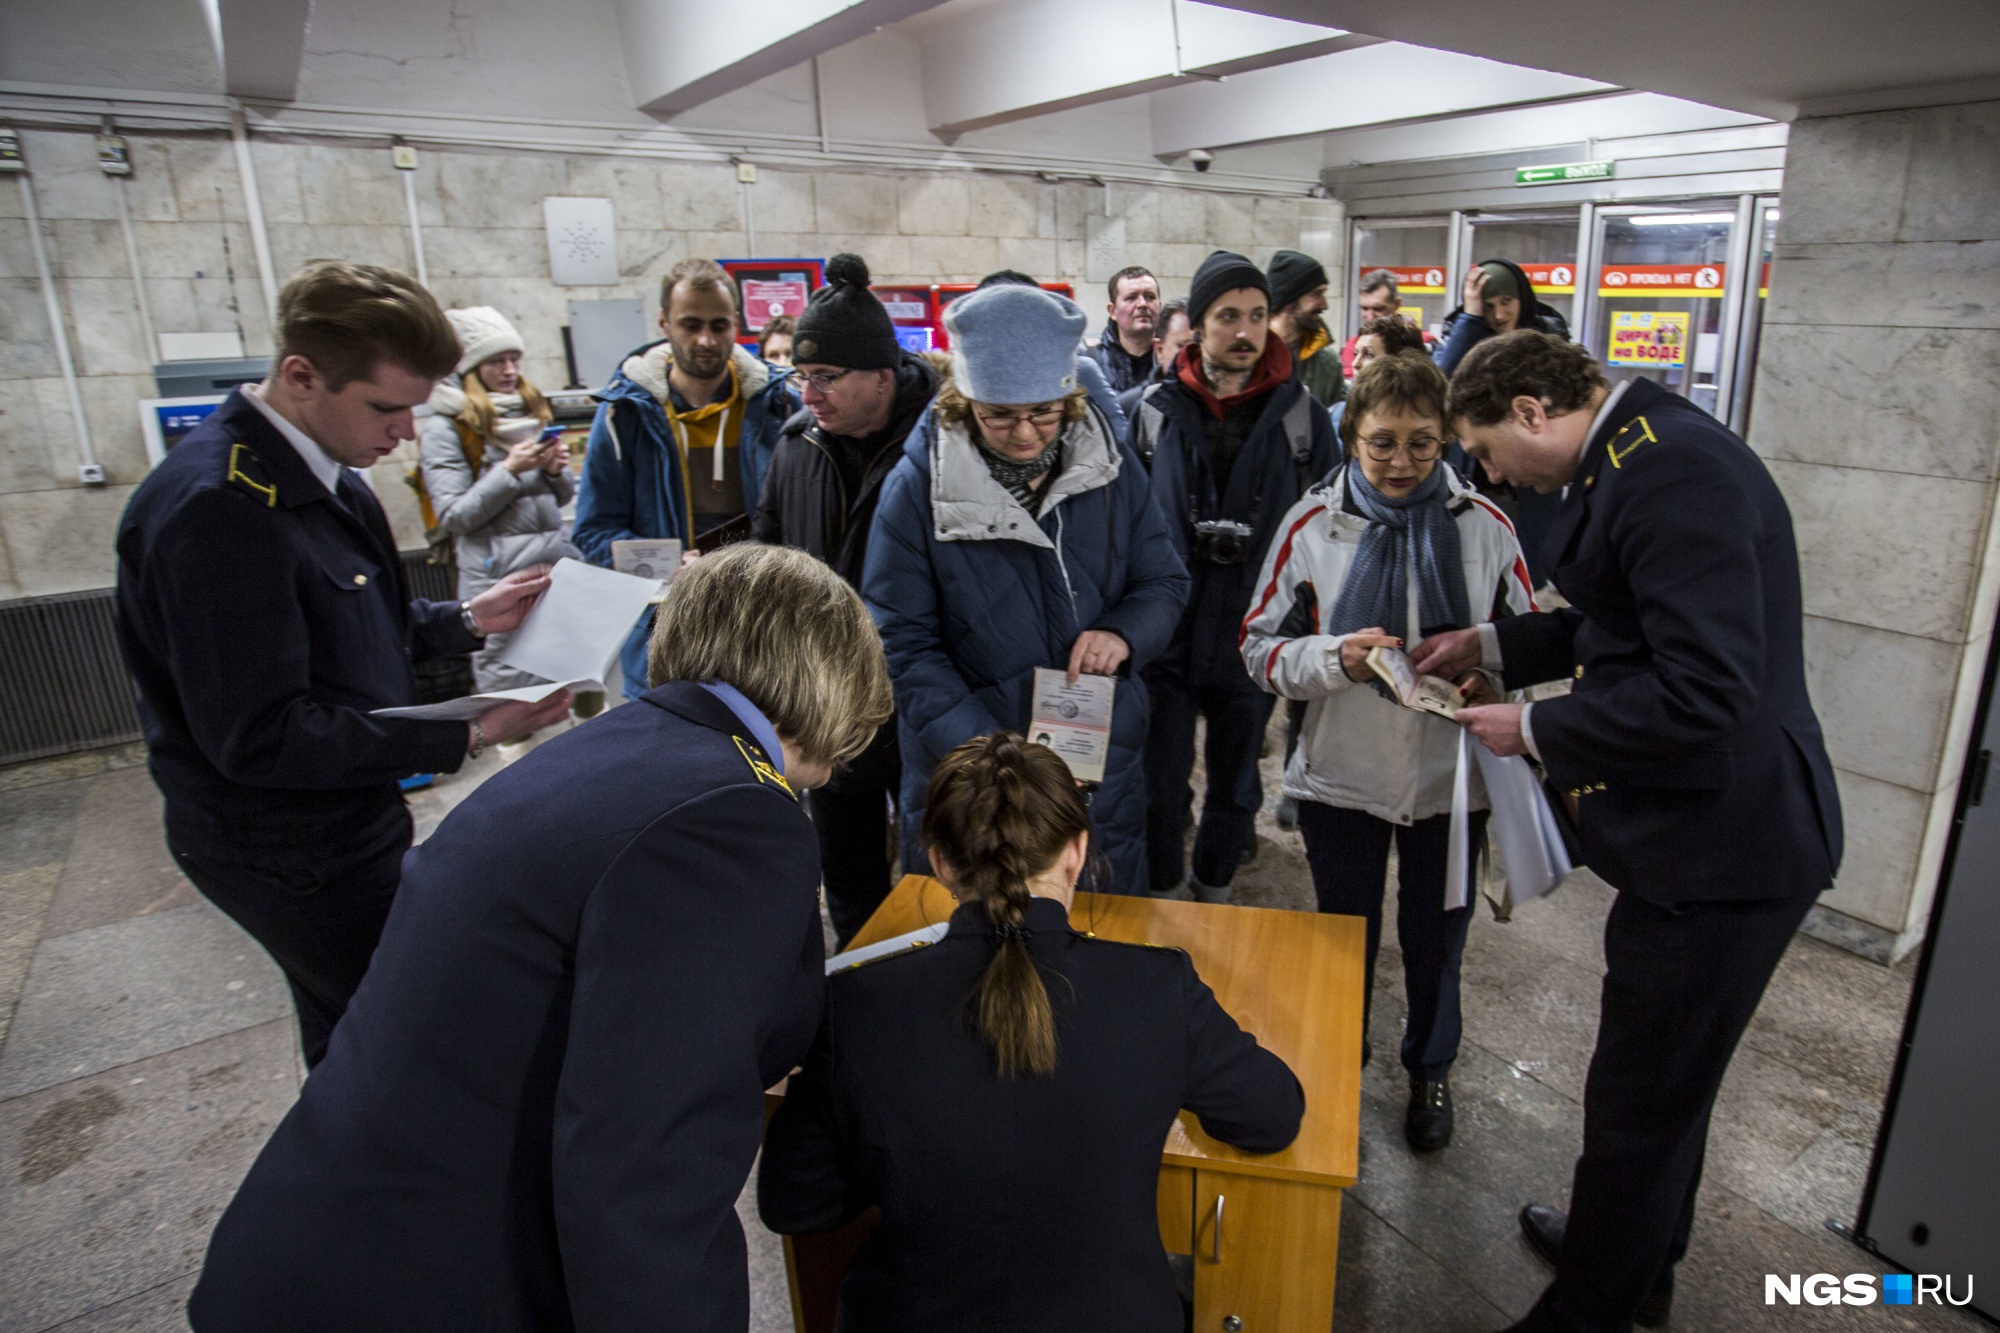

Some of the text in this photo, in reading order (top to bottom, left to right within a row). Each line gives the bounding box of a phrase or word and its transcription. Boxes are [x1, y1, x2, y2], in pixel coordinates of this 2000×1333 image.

[1564, 163, 1608, 178] ВЫХОД
[1615, 330, 1653, 344] ЦИРК
[1636, 344, 1681, 361] ВОДЕ
